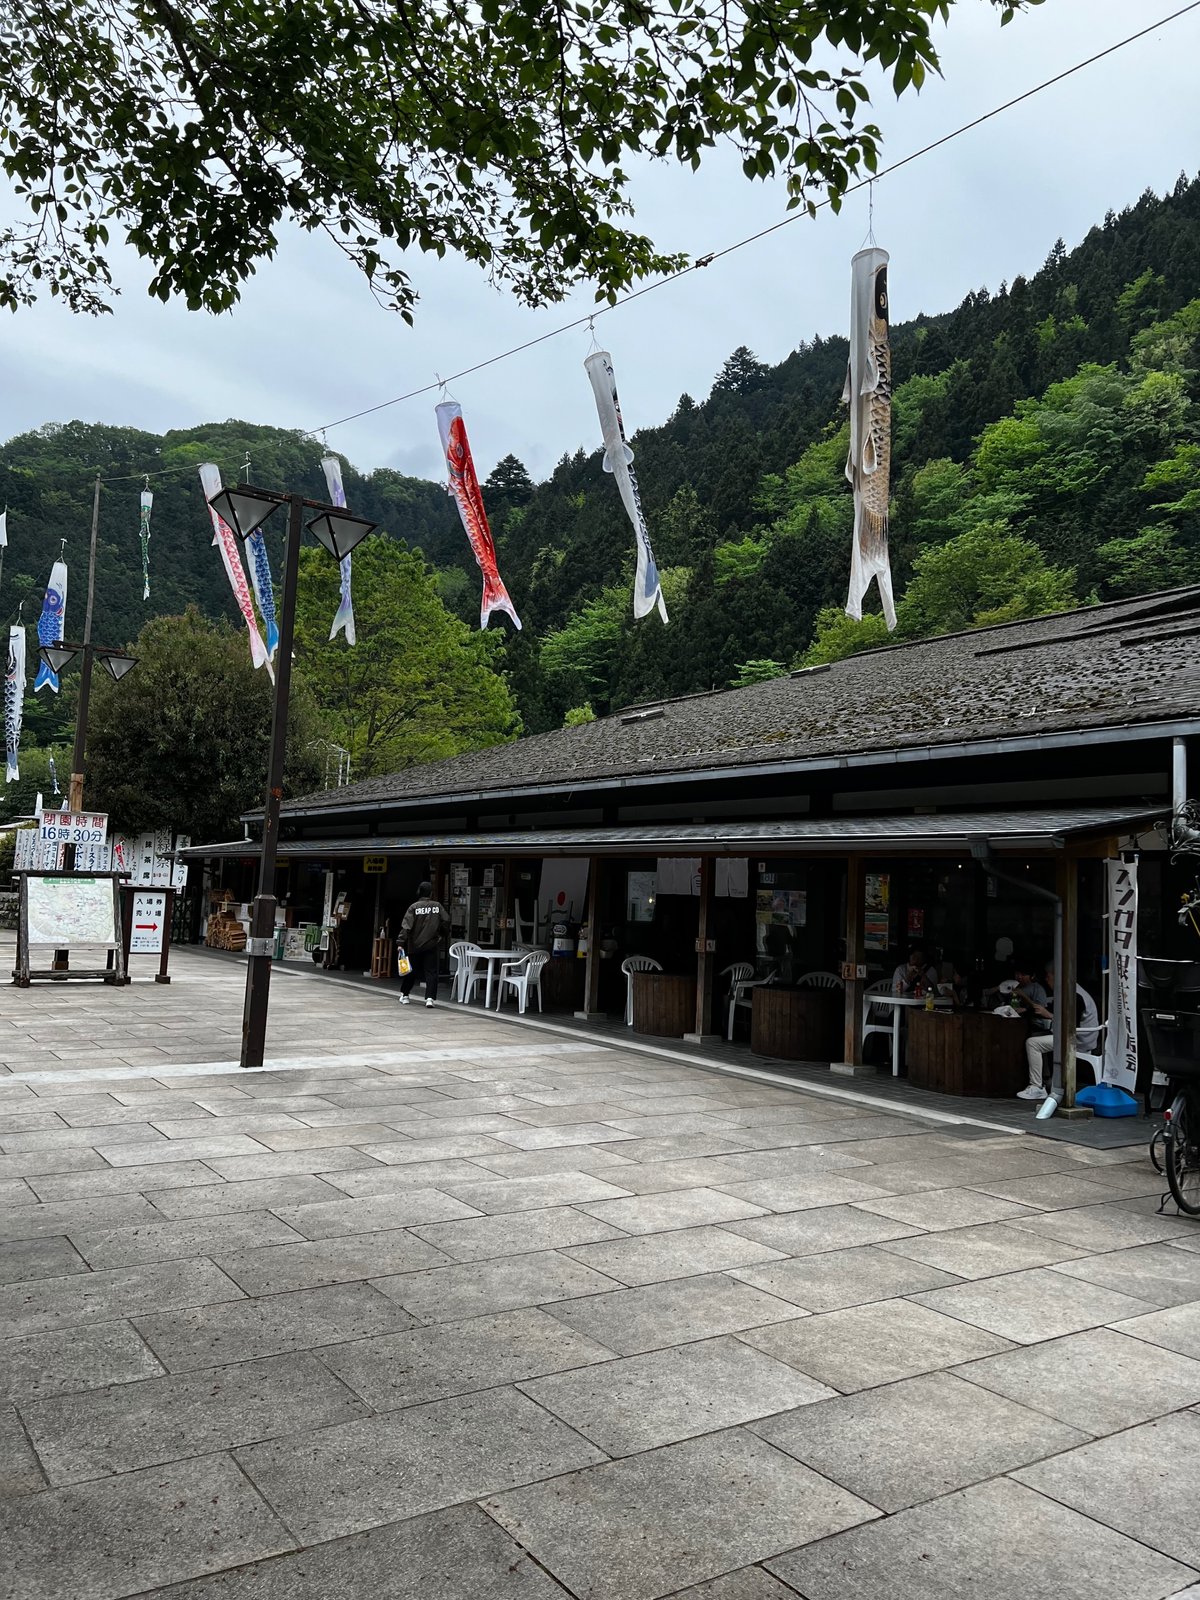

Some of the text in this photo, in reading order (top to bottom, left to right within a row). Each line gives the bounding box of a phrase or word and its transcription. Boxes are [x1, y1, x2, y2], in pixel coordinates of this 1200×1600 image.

[43, 813, 104, 828] 閉園時間
[136, 898, 163, 906] 入場券
[135, 909, 162, 917] 売り場
[415, 907, 431, 915] CREAP
